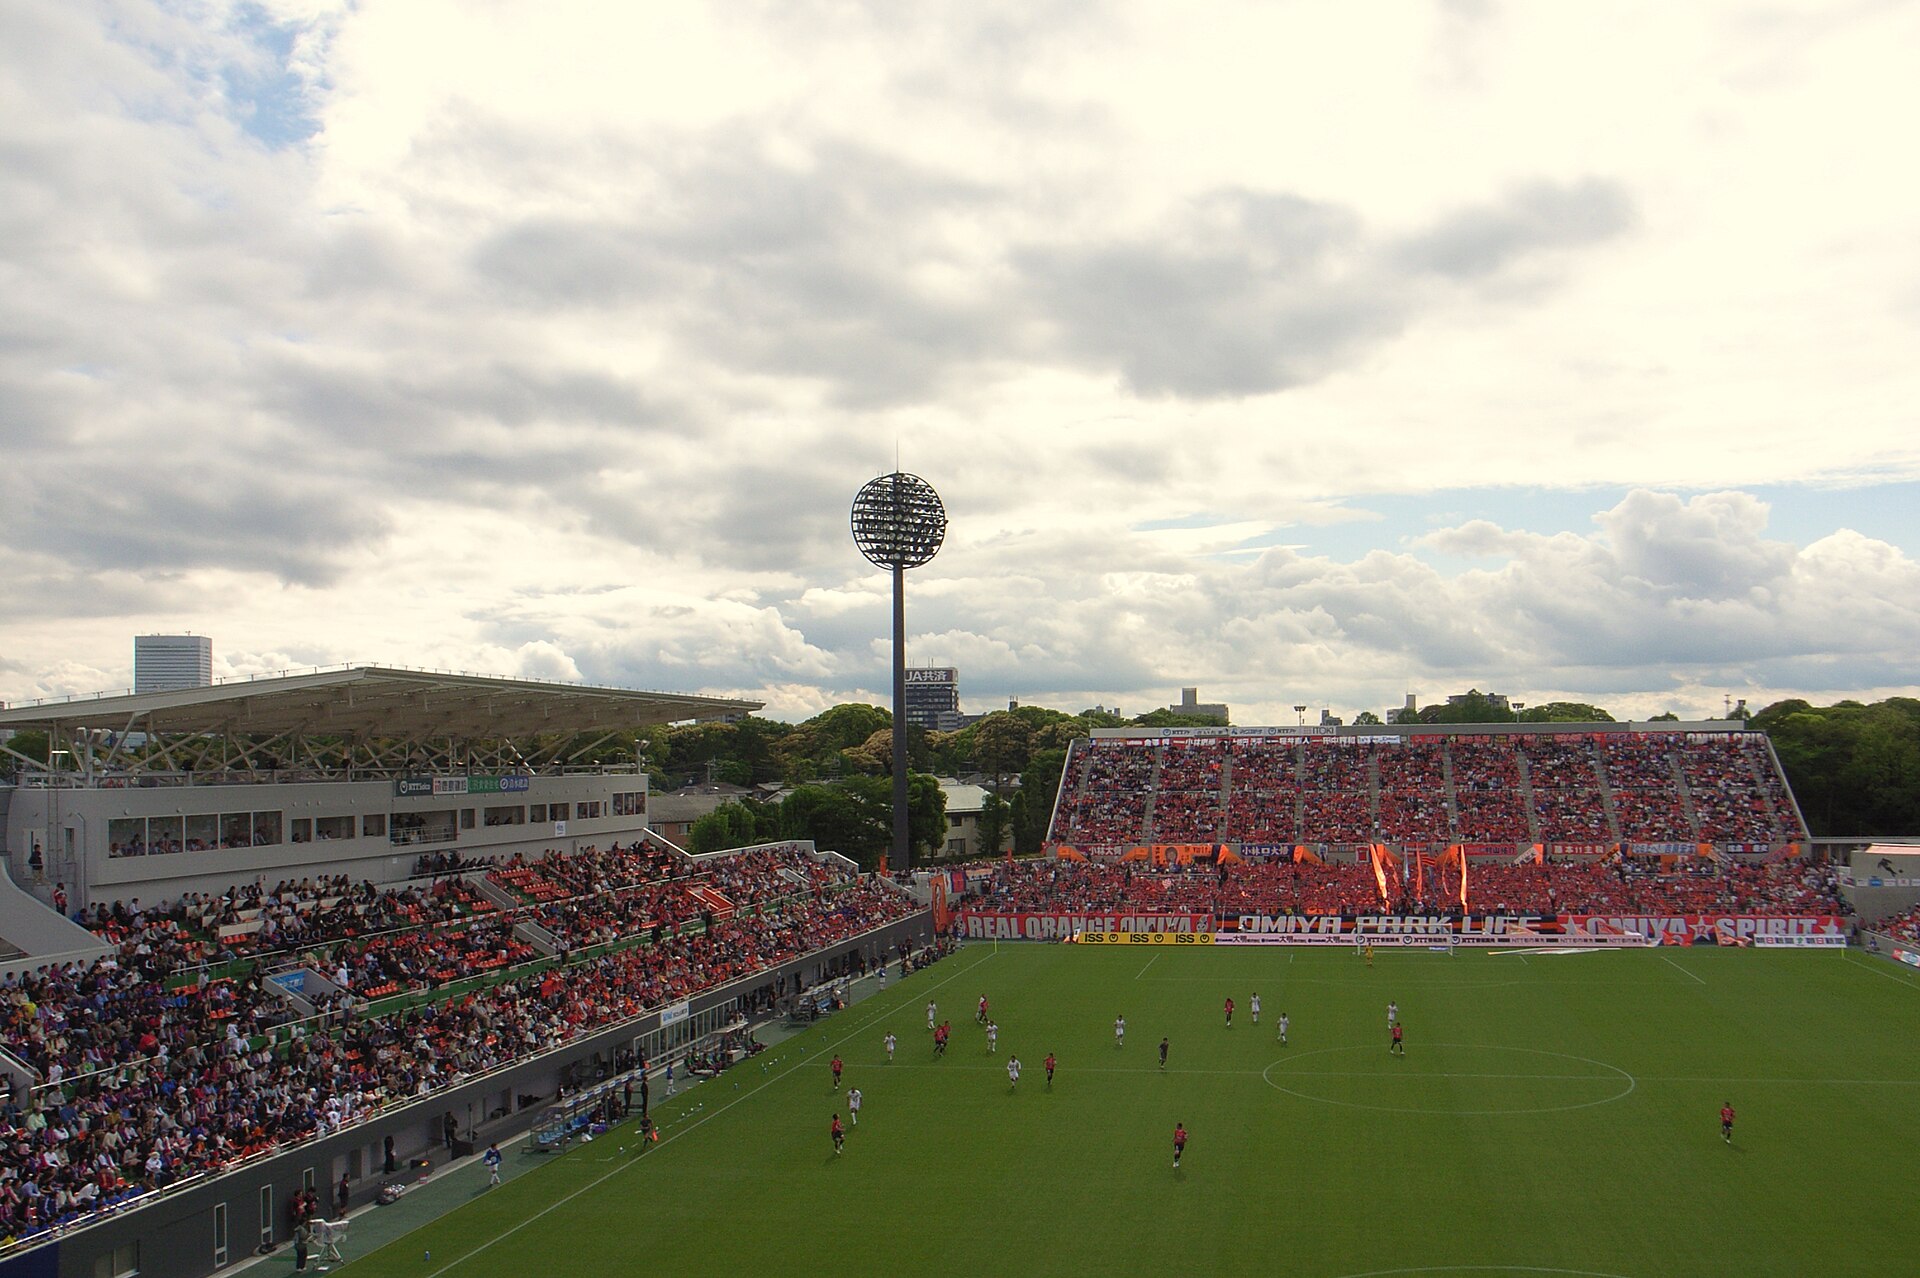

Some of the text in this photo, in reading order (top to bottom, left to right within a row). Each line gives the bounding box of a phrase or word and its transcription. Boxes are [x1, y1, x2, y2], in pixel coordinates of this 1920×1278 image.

[905, 671, 947, 682] JA共済
[1312, 726, 1334, 735] ITOKI
[967, 916, 1192, 939] REAL ORANGE OMIYA
[1239, 915, 1541, 934] OMIYA PARK LIFE
[1586, 917, 1688, 936] OMIYA
[1715, 918, 1818, 937] SPIRIT
[1084, 934, 1104, 943] ISS
[1129, 934, 1149, 943] ISS
[1175, 934, 1195, 943] ISS
